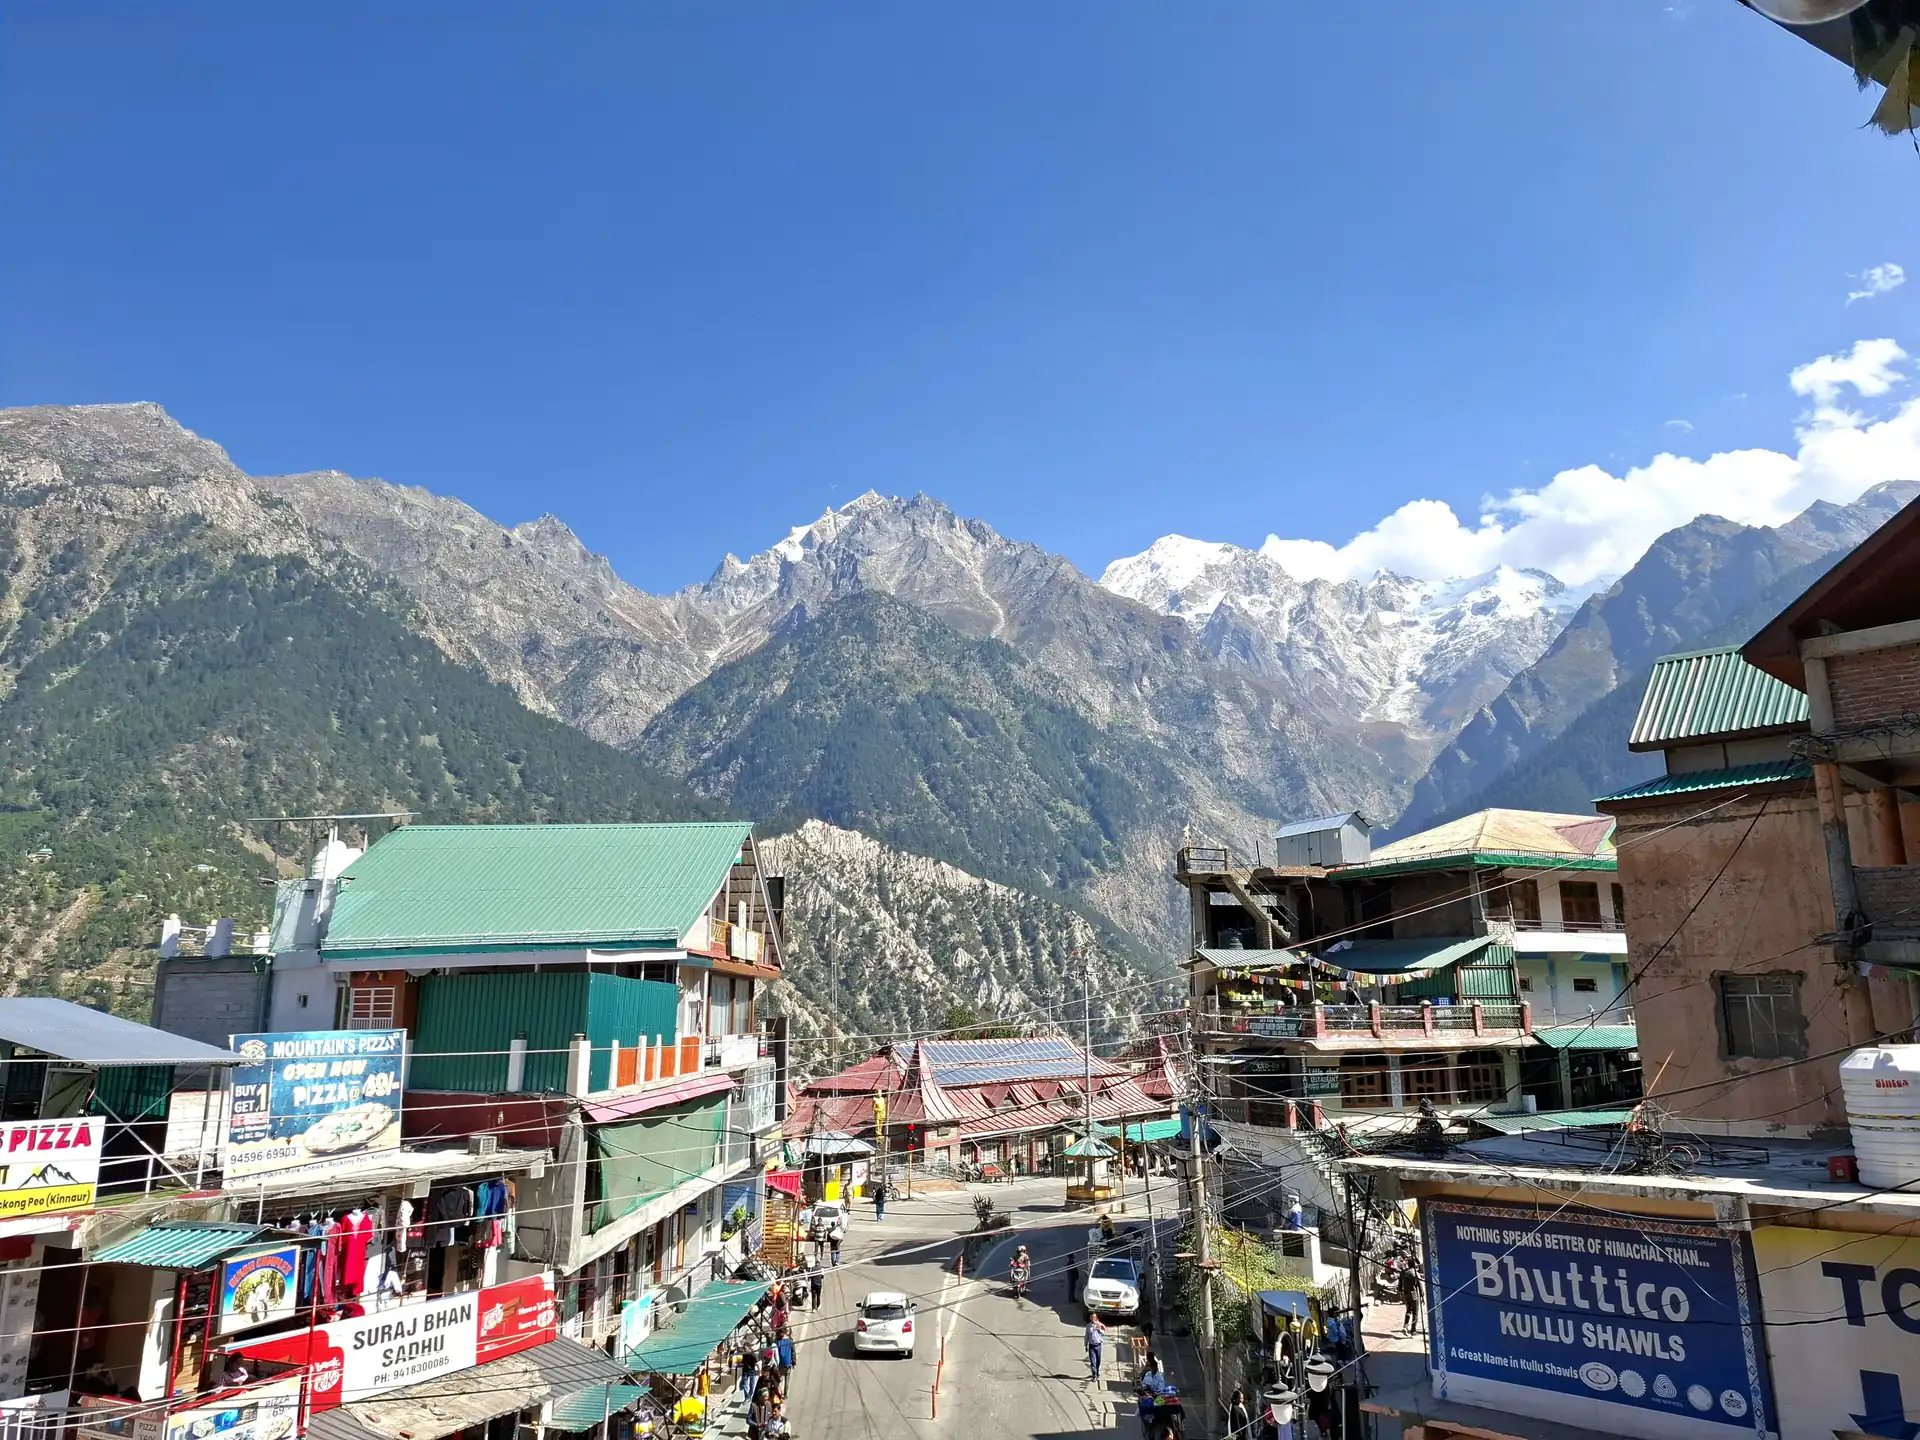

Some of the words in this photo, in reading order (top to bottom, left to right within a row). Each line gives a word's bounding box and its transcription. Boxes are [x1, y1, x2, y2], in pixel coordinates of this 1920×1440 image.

[274, 1038, 355, 1057] MOUNTAIN'S
[359, 1036, 396, 1052] PIZZA
[283, 1062, 328, 1080] OPEN
[330, 1060, 368, 1077] NOW
[235, 1084, 257, 1097] BUY
[293, 1083, 348, 1107] PIZZA
[234, 1100, 256, 1113] GET
[8, 1123, 92, 1153] PIZZA
[28, 1197, 44, 1207] Peo
[46, 1190, 90, 1208] (Kinnaur)
[1456, 1225, 1500, 1244] NOTHING
[1502, 1230, 1542, 1248] SPEAKS
[1544, 1234, 1586, 1252] BETTER
[1588, 1238, 1602, 1254] OF
[1604, 1239, 1664, 1262] HIMACHAL
[1472, 1252, 1690, 1322] Bhuttico
[353, 1318, 417, 1350] SURAJ
[424, 1304, 472, 1332] BHAN
[1500, 1312, 1575, 1344] KULLU
[1582, 1322, 1686, 1362] SHAWLS
[382, 1335, 445, 1368] SADHU
[1450, 1347, 1457, 1358] A
[1458, 1348, 1482, 1362] Great
[1484, 1352, 1509, 1366] Name
[1510, 1356, 1518, 1368] in
[1520, 1358, 1544, 1373] Kullu
[1545, 1362, 1578, 1380] Shawls
[374, 1372, 390, 1386] PH:
[393, 1356, 450, 1380] 9418300085
[264, 1395, 290, 1408] PIZZA
